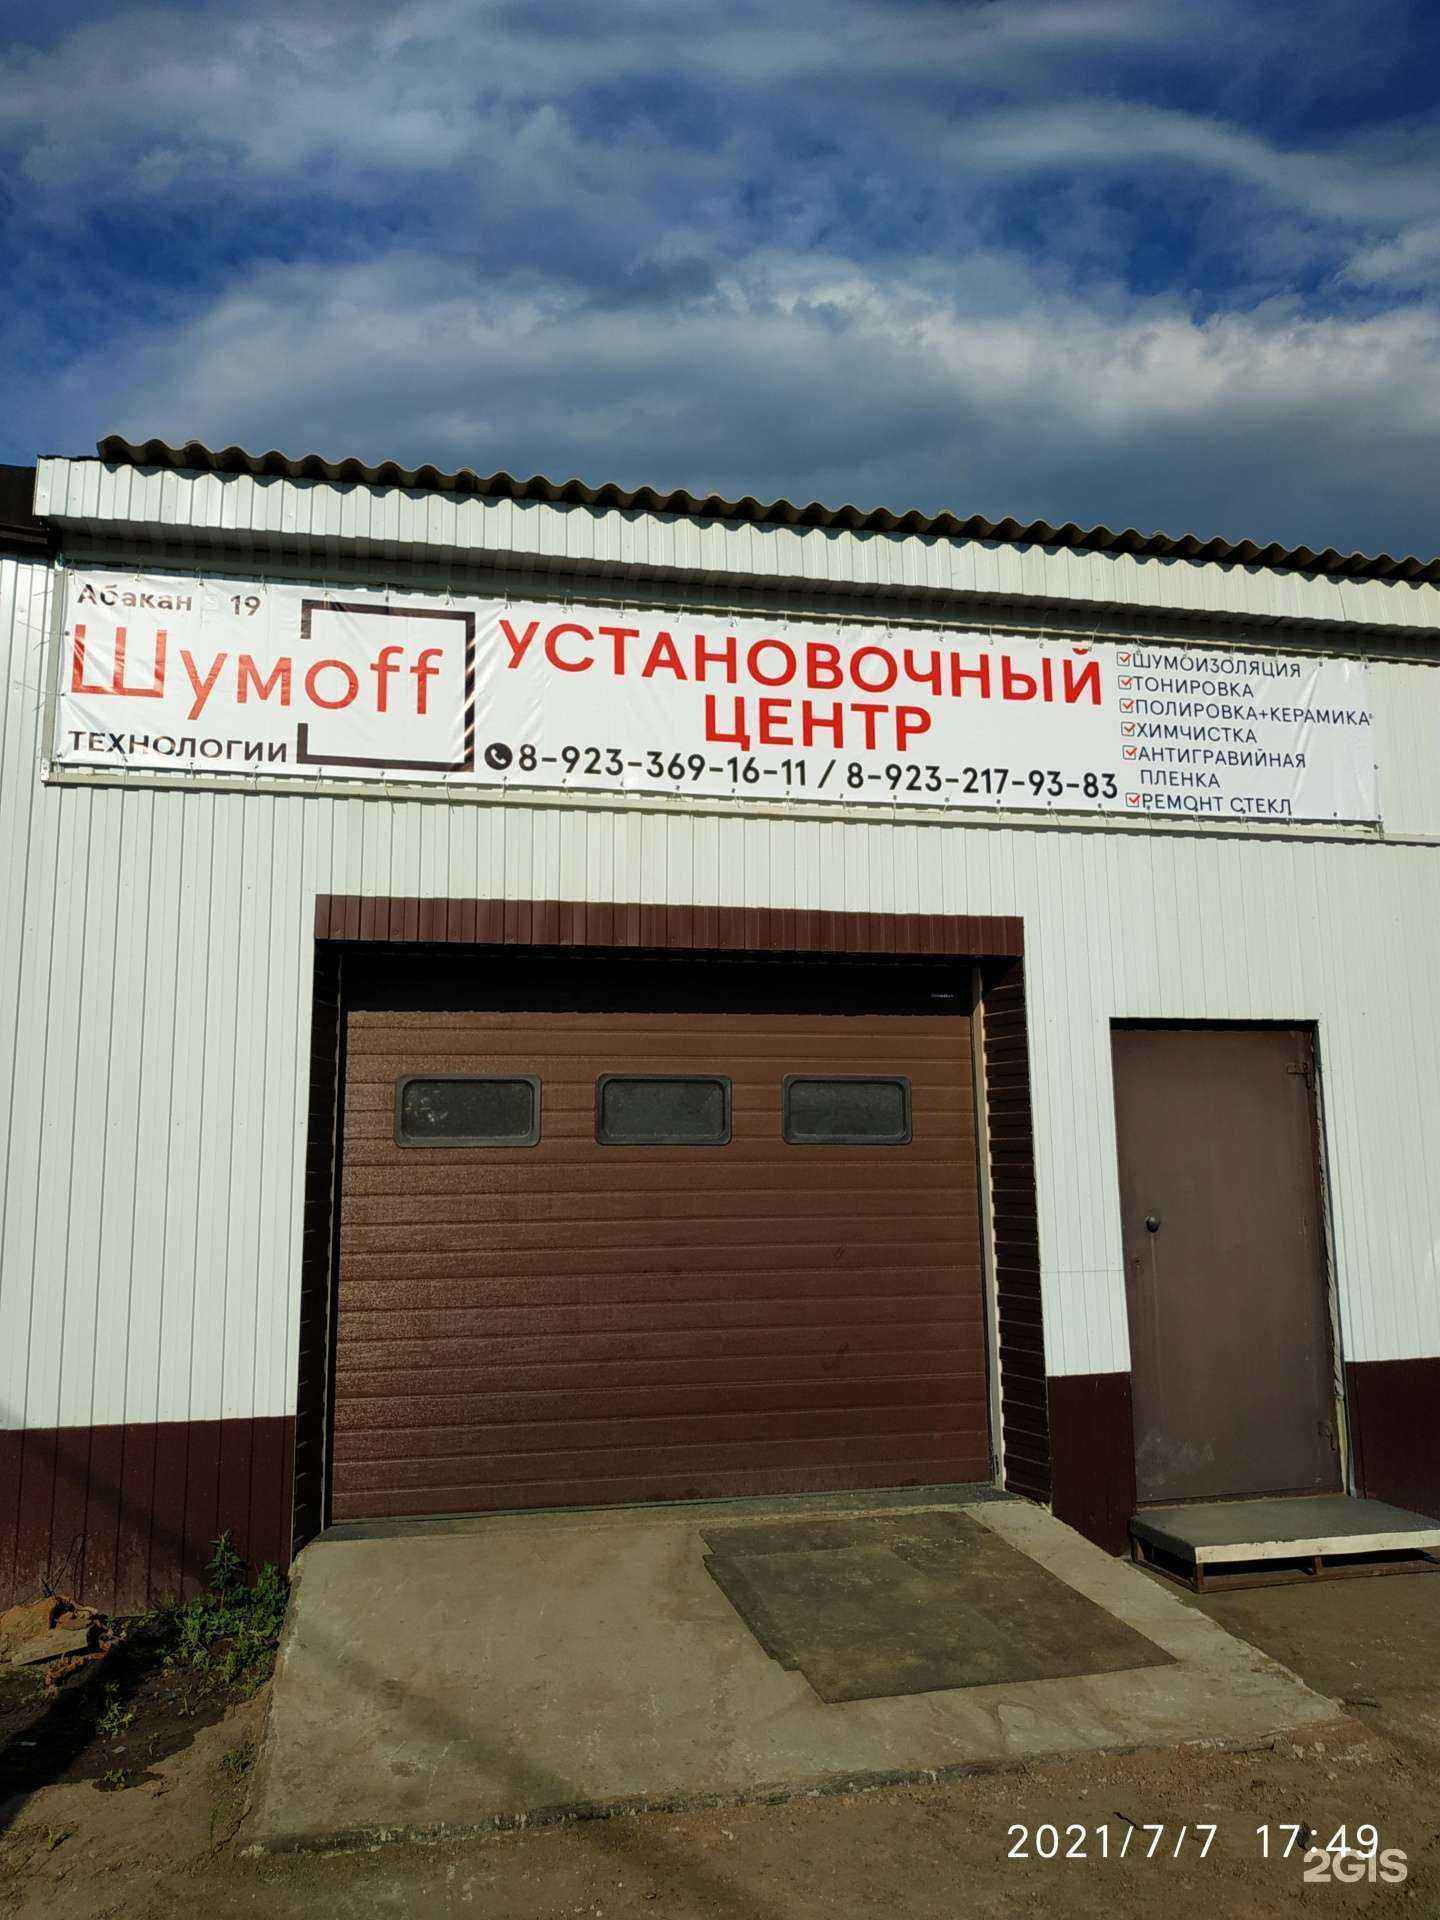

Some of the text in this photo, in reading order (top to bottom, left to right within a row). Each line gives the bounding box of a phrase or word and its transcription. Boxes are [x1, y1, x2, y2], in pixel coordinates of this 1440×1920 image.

[77, 584, 261, 616] Абакан 19
[499, 619, 1103, 705] УСТАНОВОЧНЫЙ
[1133, 654, 1301, 678] ШУМОИЗОЛЯЦИЯ
[1134, 676, 1254, 698] ТОНИРОВКА
[704, 694, 932, 751] ЦЕНТР
[1135, 700, 1370, 726] ПОЛИРОВКА+КЕРАМИКА
[1137, 722, 1257, 743] ХИМЧИСТКА
[68, 730, 287, 763] ТЕХНОЛОГИИ
[1138, 746, 1306, 768] АНТИГРАВИЙНАЯ
[518, 745, 807, 786] 8-923-369-16-11
[847, 762, 1118, 800] 8-923-217-93-83
[1141, 769, 1221, 788] ПЛЕНКА
[1142, 794, 1292, 815] РЕМОНТ СТЕКЛ
